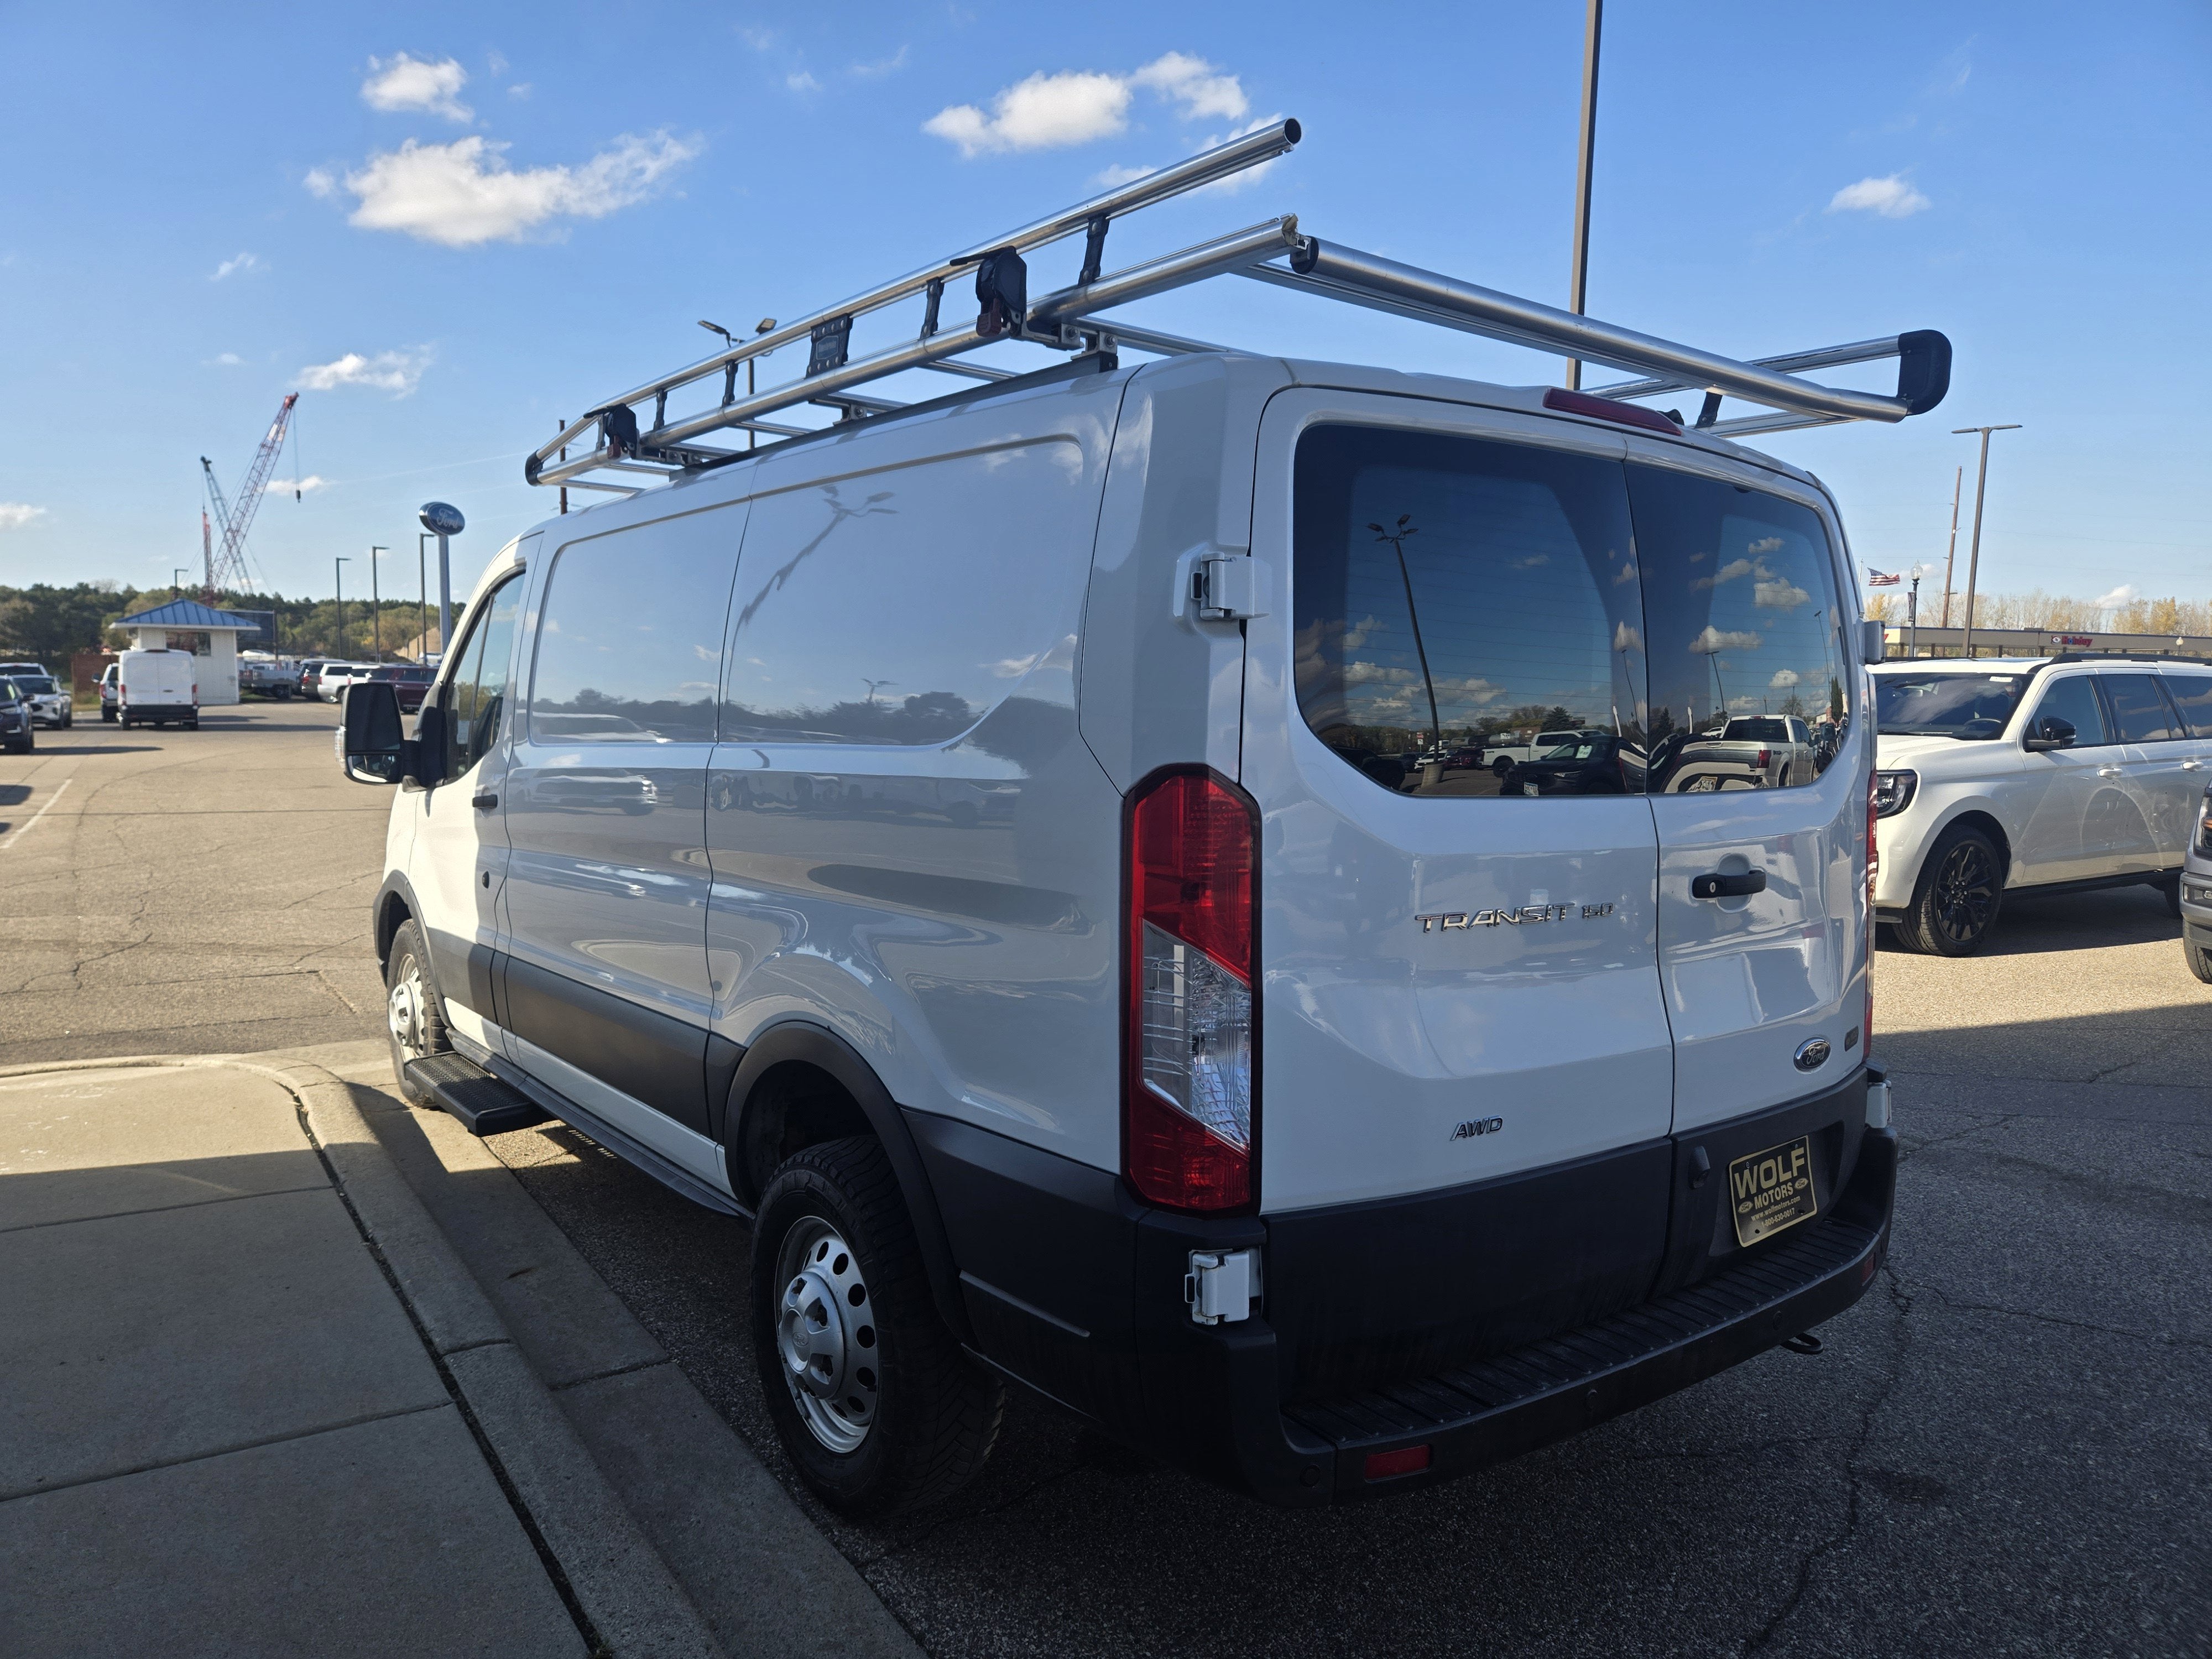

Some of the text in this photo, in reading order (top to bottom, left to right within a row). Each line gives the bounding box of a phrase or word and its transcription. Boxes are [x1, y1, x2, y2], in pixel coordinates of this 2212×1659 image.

[436, 508, 459, 529] Ford
[1415, 902, 1614, 933] TRANSIT 150
[1807, 1045, 1825, 1065] Ford
[1450, 1115, 1503, 1141] AWD
[1734, 1147, 1805, 1199] WOLF
[1751, 1196, 1801, 1222] www.wolfmotors.com
[1754, 1182, 1794, 1210] MOTORS
[1761, 1207, 1795, 1228] 1-800-830-0017
